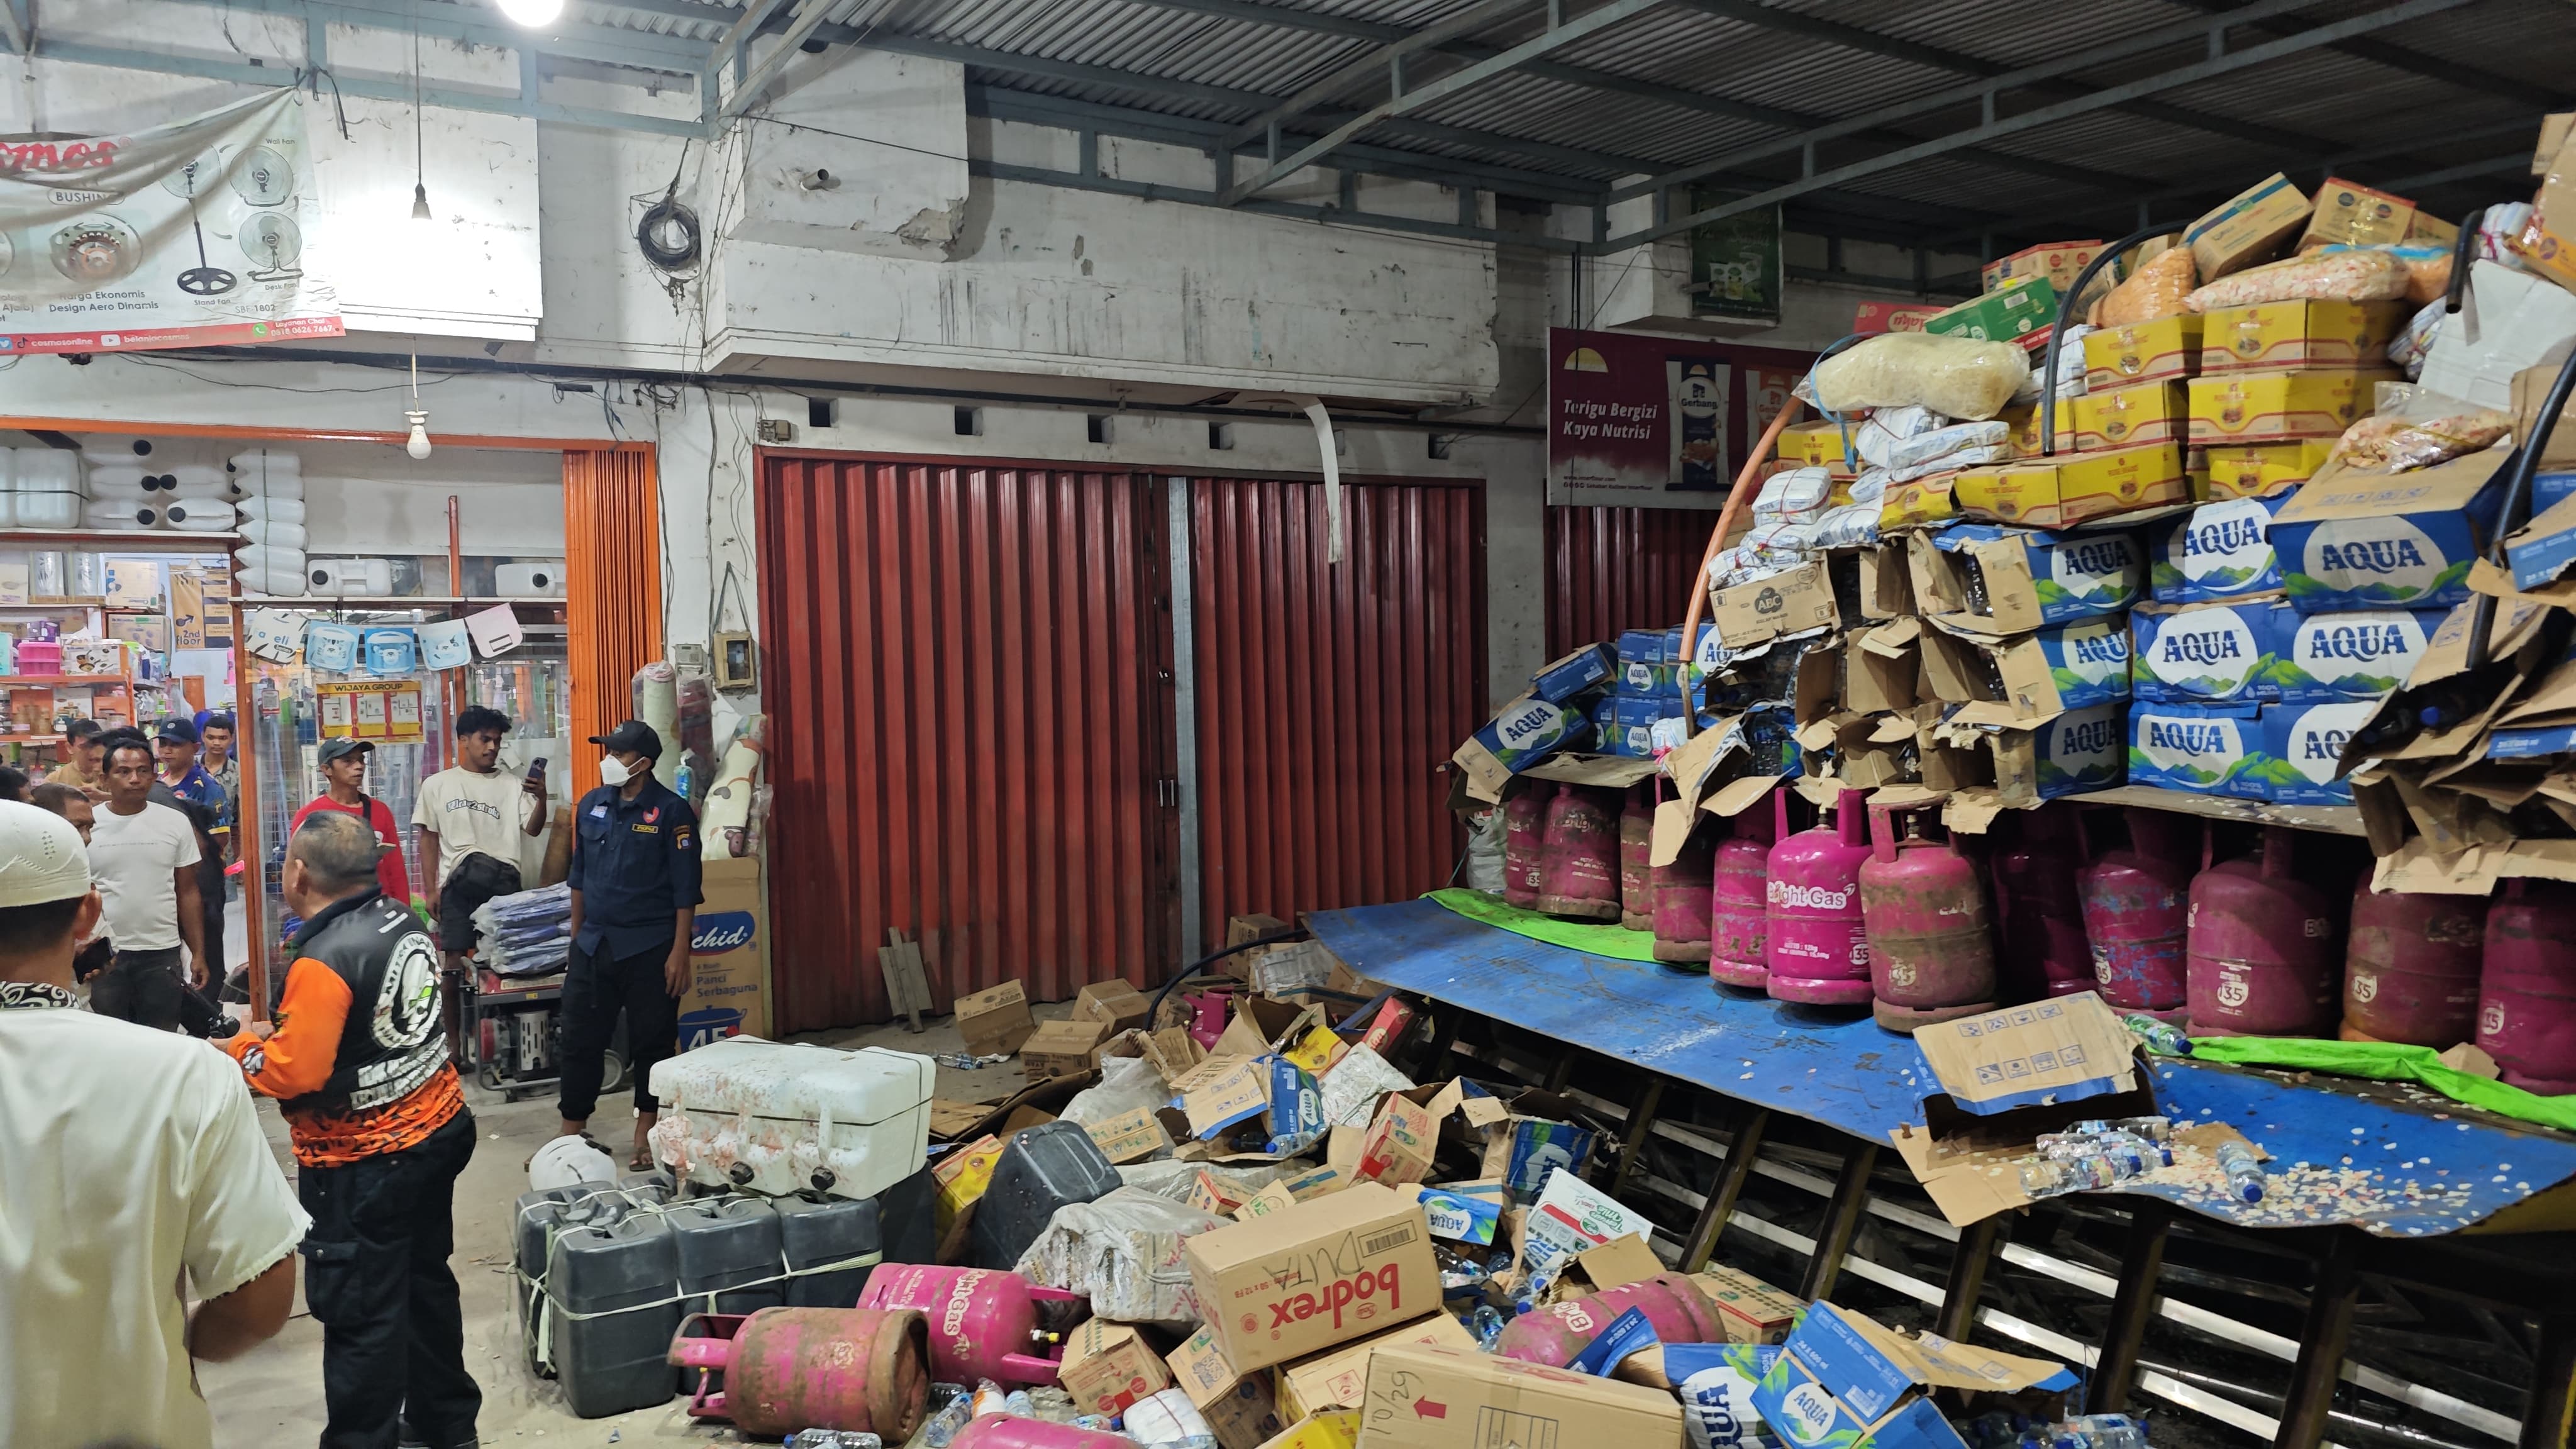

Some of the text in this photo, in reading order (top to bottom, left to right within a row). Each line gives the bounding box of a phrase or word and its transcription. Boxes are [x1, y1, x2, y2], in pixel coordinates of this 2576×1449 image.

[0, 142, 119, 171] mos
[56, 192, 119, 203] BUSHIN
[96, 289, 145, 299] Ekonomis
[49, 303, 86, 313] Design
[118, 301, 158, 310] Dinamis
[31, 338, 94, 347] cosmosonline
[1564, 399, 1658, 421] Terigu Bergizi
[1681, 398, 1718, 409] Gerbang
[1563, 421, 1651, 440] Kaya Nutrisi
[2182, 516, 2263, 557] AQUA
[2066, 540, 2133, 575] AQUA
[2321, 539, 2426, 574] AQUA
[1758, 596, 1782, 611] ABC
[176, 635, 201, 645] floor
[183, 630, 200, 638] 2nd
[2309, 623, 2409, 662] AQUA
[2075, 631, 2128, 662] AQU
[2163, 631, 2241, 665] AQUA
[1629, 669, 1648, 679] AQUA
[1505, 706, 1553, 743] AQUA
[1630, 732, 1648, 743] AQUA
[2063, 718, 2121, 755] AQUA
[2150, 722, 2227, 757] AQUA
[2304, 730, 2353, 761] AQ
[1811, 890, 1844, 907] Gas
[692, 925, 745, 950] chid
[1850, 948, 1869, 960] 135
[697, 974, 726, 985] Panci
[697, 984, 758, 998] Serbaguna
[2219, 986, 2243, 1002] 135
[1430, 1214, 1464, 1231] AQUA
[1262, 1231, 1364, 1292] DUTA
[1268, 1263, 1400, 1330] bodrex
[947, 1298, 966, 1333] Gas
[1696, 1383, 1743, 1449] UA
[1793, 1391, 1829, 1428] AQUA
